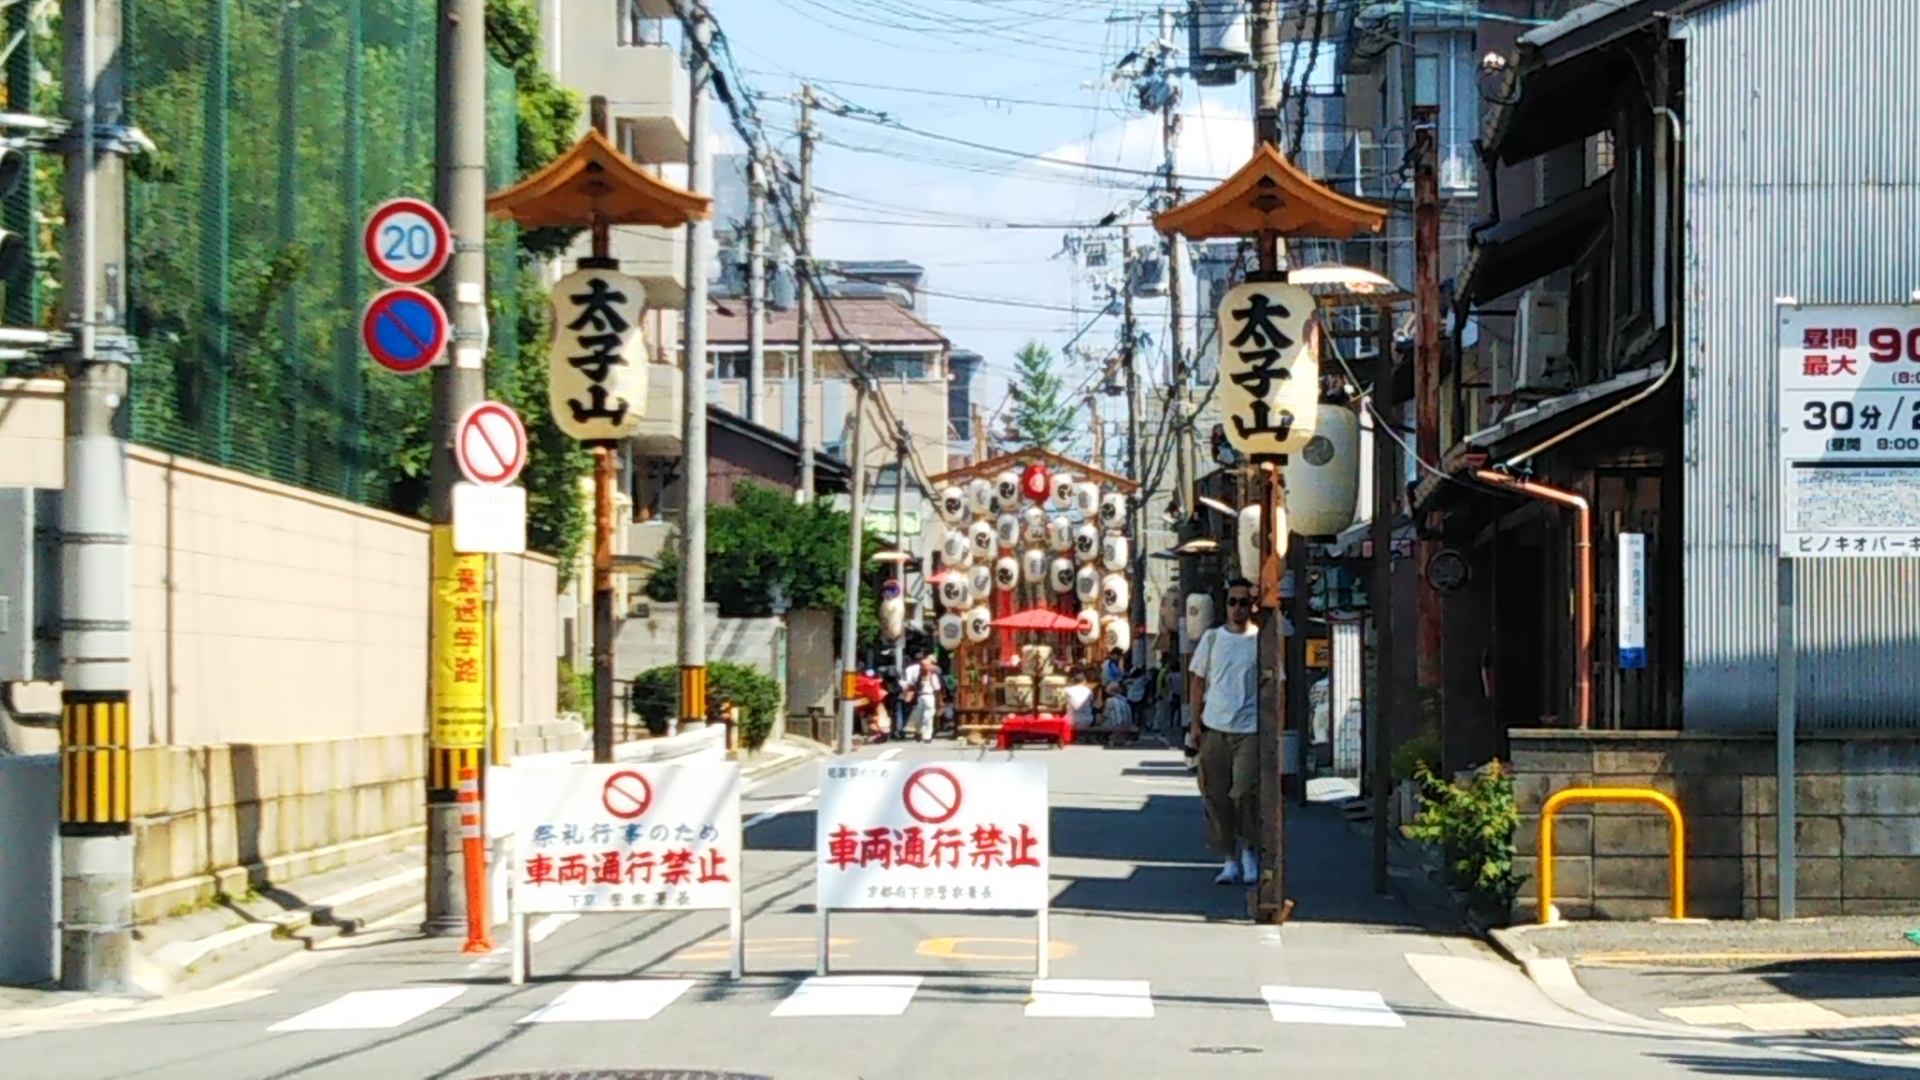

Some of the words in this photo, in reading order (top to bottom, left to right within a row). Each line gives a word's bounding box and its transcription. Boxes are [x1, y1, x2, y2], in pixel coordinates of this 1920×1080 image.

[383, 224, 430, 261] 20
[566, 277, 629, 428] 太子山
[1802, 327, 1858, 350] 昼間
[1228, 293, 1295, 443] 太子山
[1802, 355, 1858, 377] 最大
[1802, 395, 1920, 431] 30分/
[453, 552, 480, 684] 童通学路
[532, 822, 720, 849] 祭礼行事のため
[825, 823, 1042, 872] 車両通行禁止
[523, 847, 732, 888] 車両通行禁止
